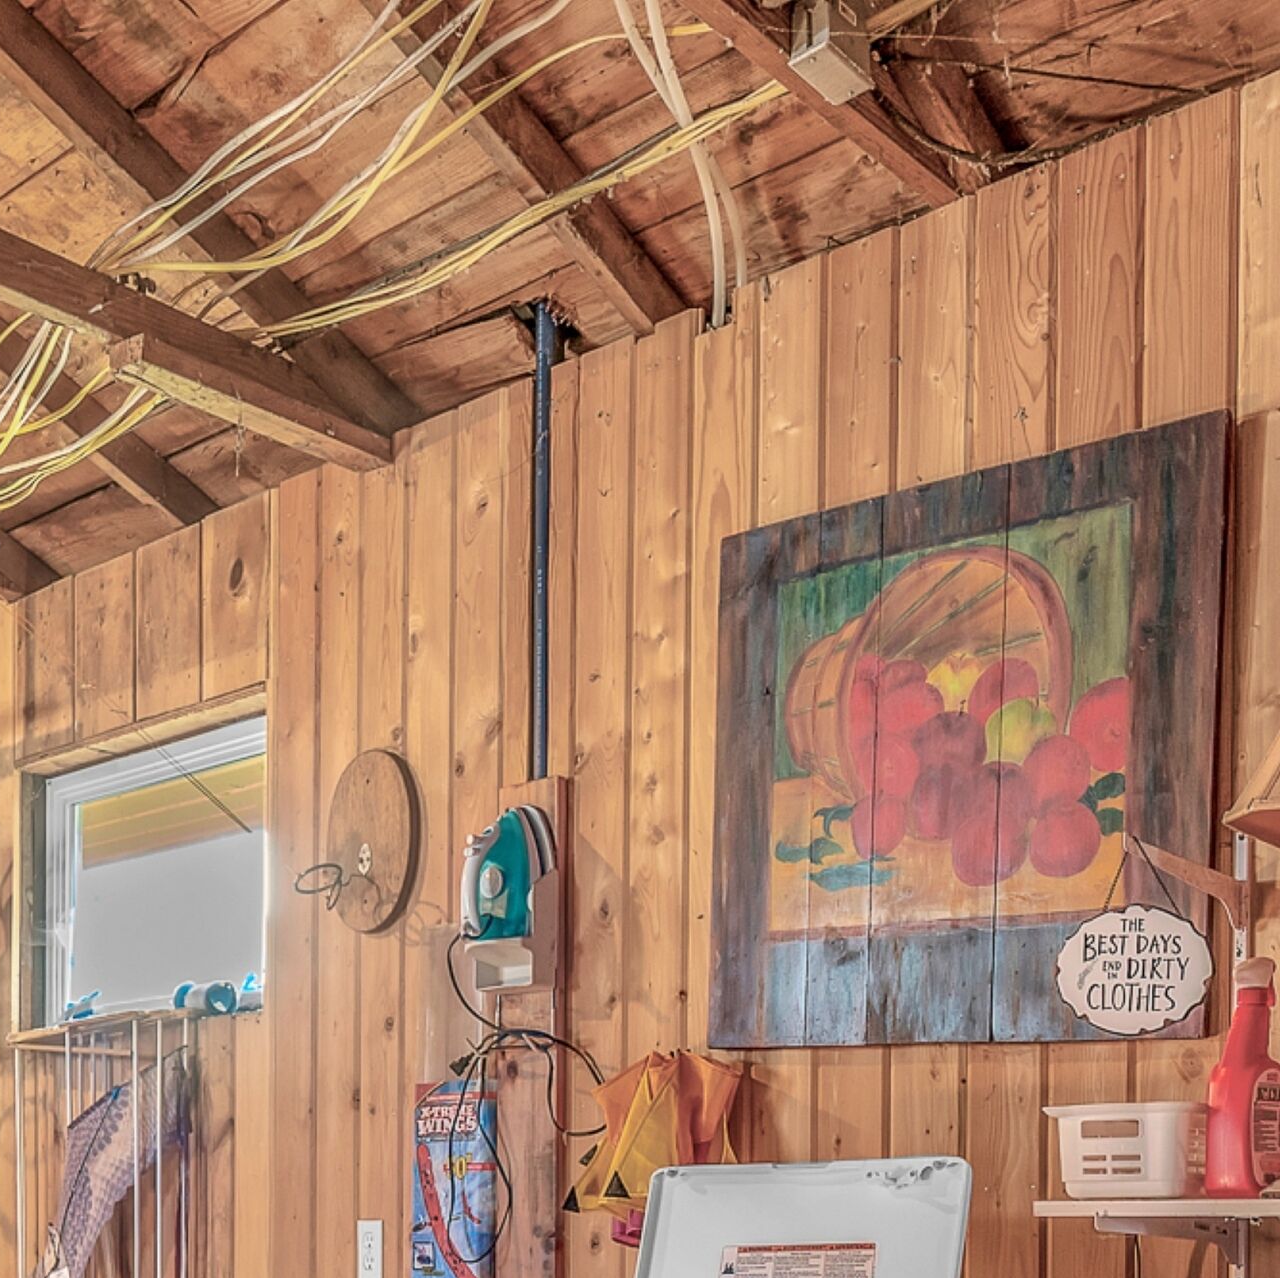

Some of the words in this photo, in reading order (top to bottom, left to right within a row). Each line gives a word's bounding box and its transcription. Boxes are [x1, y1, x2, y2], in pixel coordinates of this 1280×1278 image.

[1120, 918, 1146, 932] THE
[1082, 933, 1130, 963] BEST
[1136, 934, 1182, 955] DAYS
[1102, 960, 1122, 972] END
[1126, 957, 1189, 981] DIRTY
[1086, 983, 1176, 1013] CLOTHES
